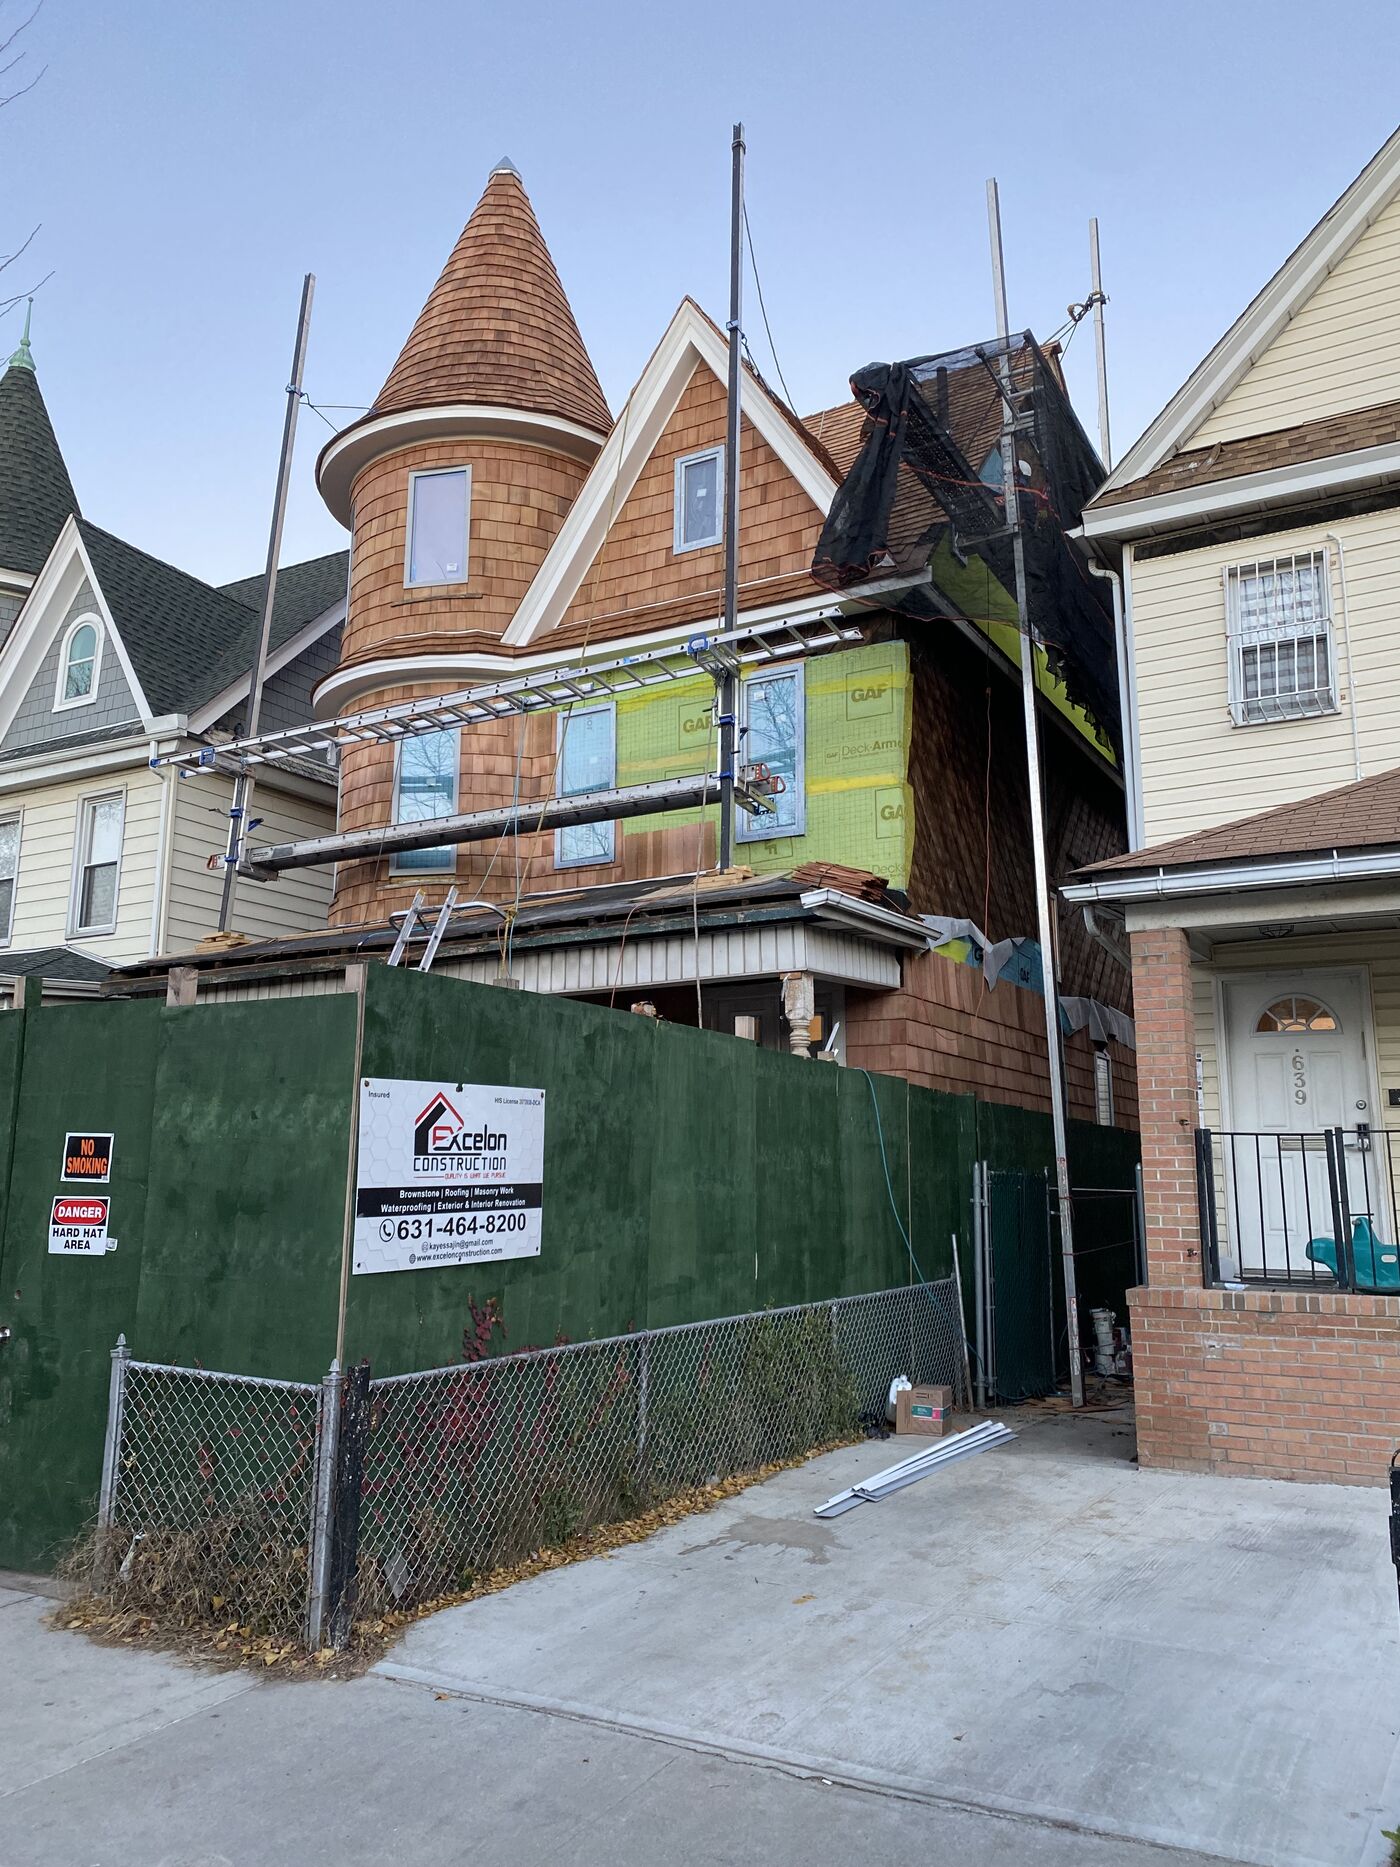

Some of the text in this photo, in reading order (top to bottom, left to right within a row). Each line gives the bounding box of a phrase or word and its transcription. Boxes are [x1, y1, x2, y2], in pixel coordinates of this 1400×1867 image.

[851, 683, 888, 702] GAF
[881, 804, 904, 820] GA
[1292, 1055, 1307, 1105] 639
[368, 1090, 391, 1098] Insured
[432, 1124, 507, 1151] Excelon
[81, 1139, 95, 1155] NO
[66, 1157, 108, 1174] SMOKING
[413, 1157, 507, 1171] CONSTRUCTION
[400, 1186, 514, 1199] Brownstone Roofing Masonry Work
[57, 1206, 103, 1218] DANGER
[381, 1198, 525, 1214] Waterproofing Exterior & Interior Renovation
[52, 1227, 104, 1239] HARD HAT
[397, 1212, 526, 1240] 631-464-8200
[64, 1240, 91, 1250] AREA
[417, 1247, 503, 1262] www.excelonconstruction.com
